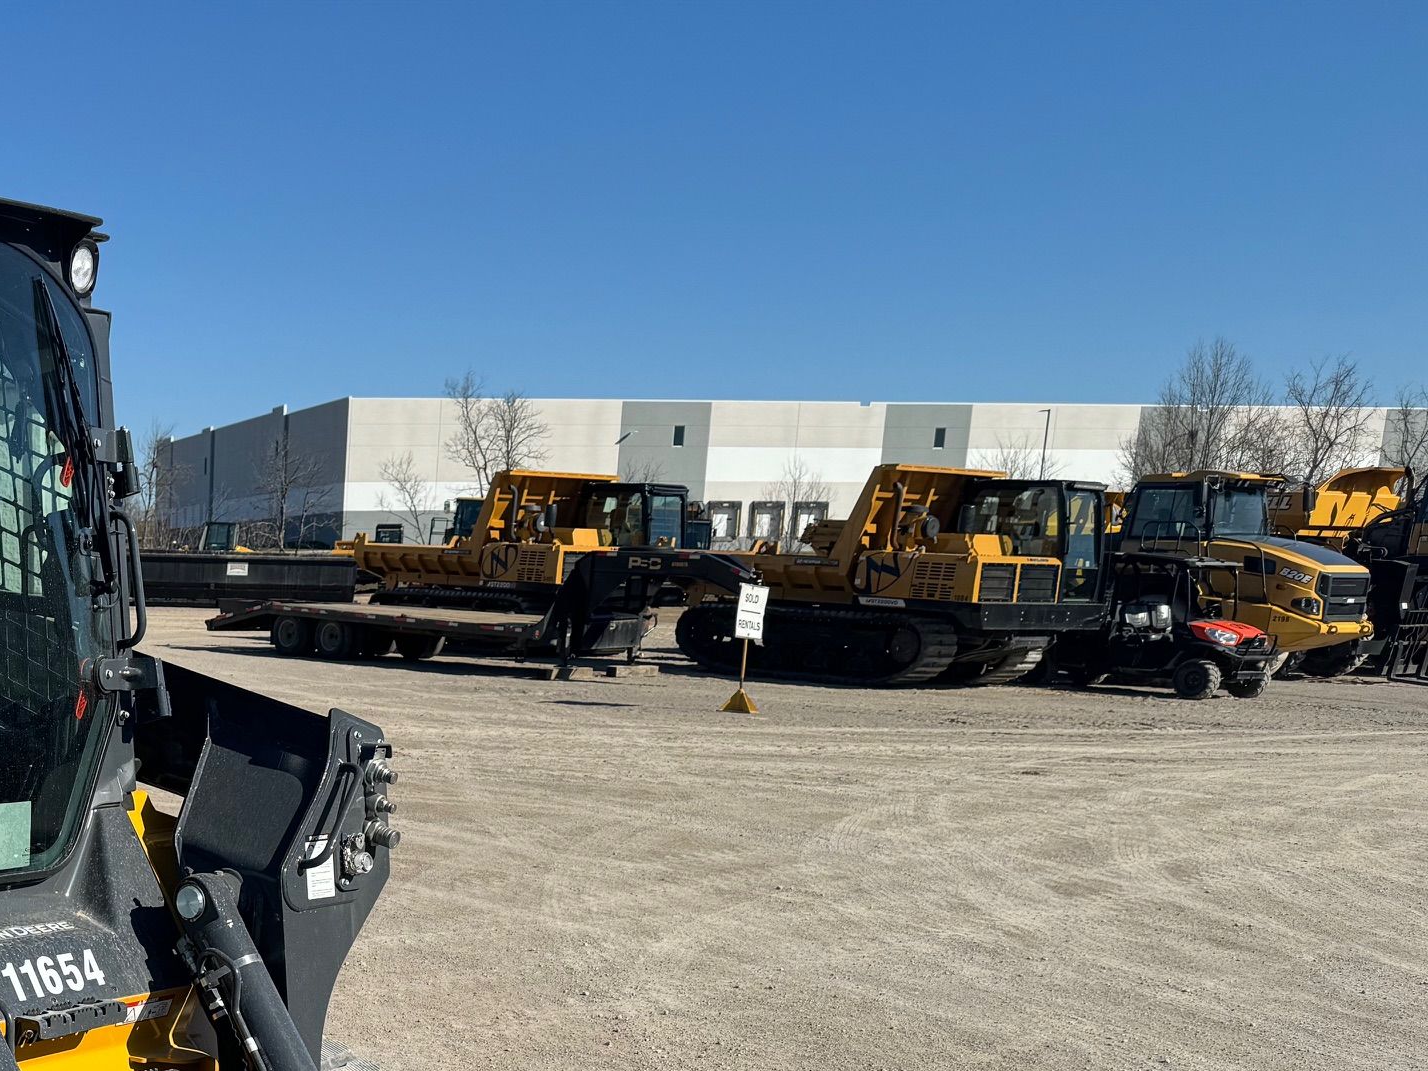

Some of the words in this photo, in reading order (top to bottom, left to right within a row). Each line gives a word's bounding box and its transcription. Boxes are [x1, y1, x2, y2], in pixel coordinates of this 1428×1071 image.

[1279, 567, 1314, 585] B20E
[744, 593, 760, 604] SOLD
[738, 619, 761, 631] RENTALS
[12, 921, 75, 938] DEERE
[1, 949, 106, 1002] 11654
